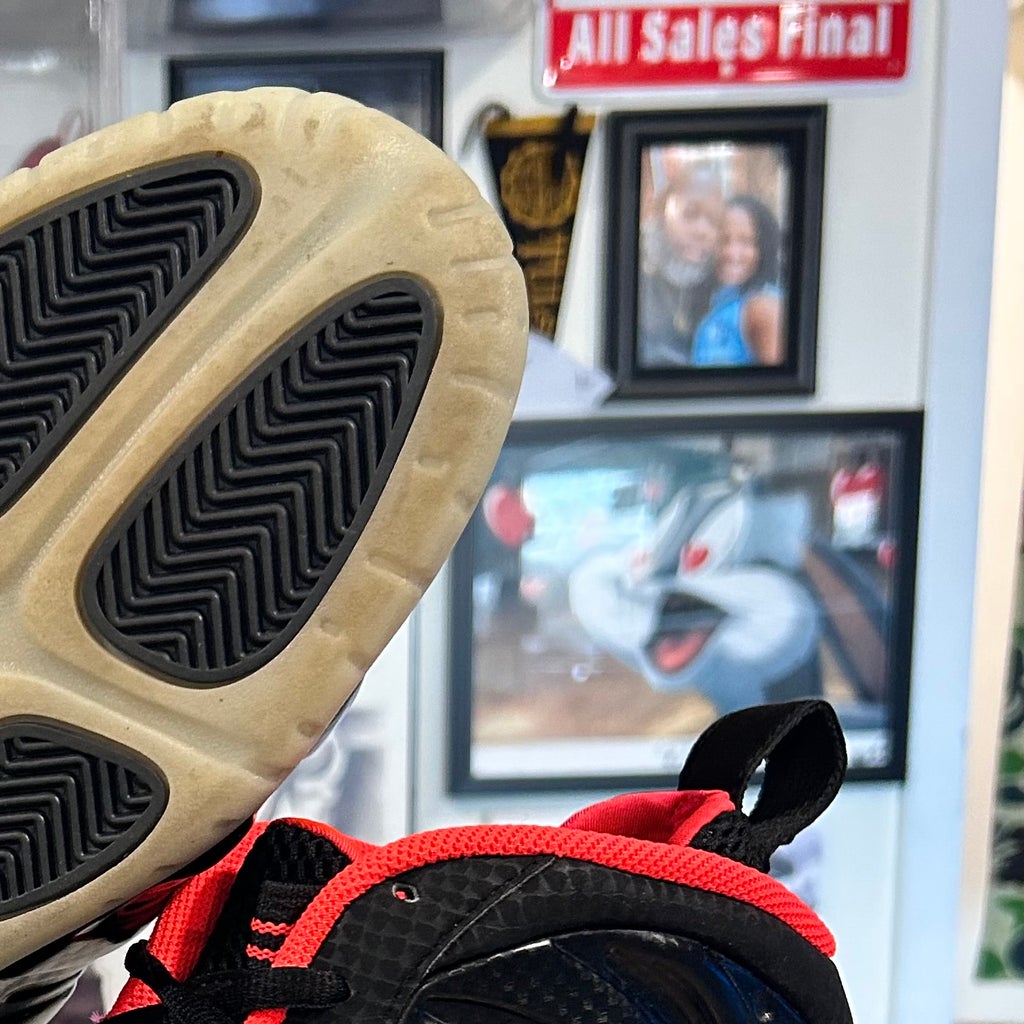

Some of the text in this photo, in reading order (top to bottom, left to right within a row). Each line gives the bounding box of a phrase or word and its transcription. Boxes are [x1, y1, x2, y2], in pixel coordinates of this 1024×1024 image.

[567, 4, 893, 65] All Sales Final
